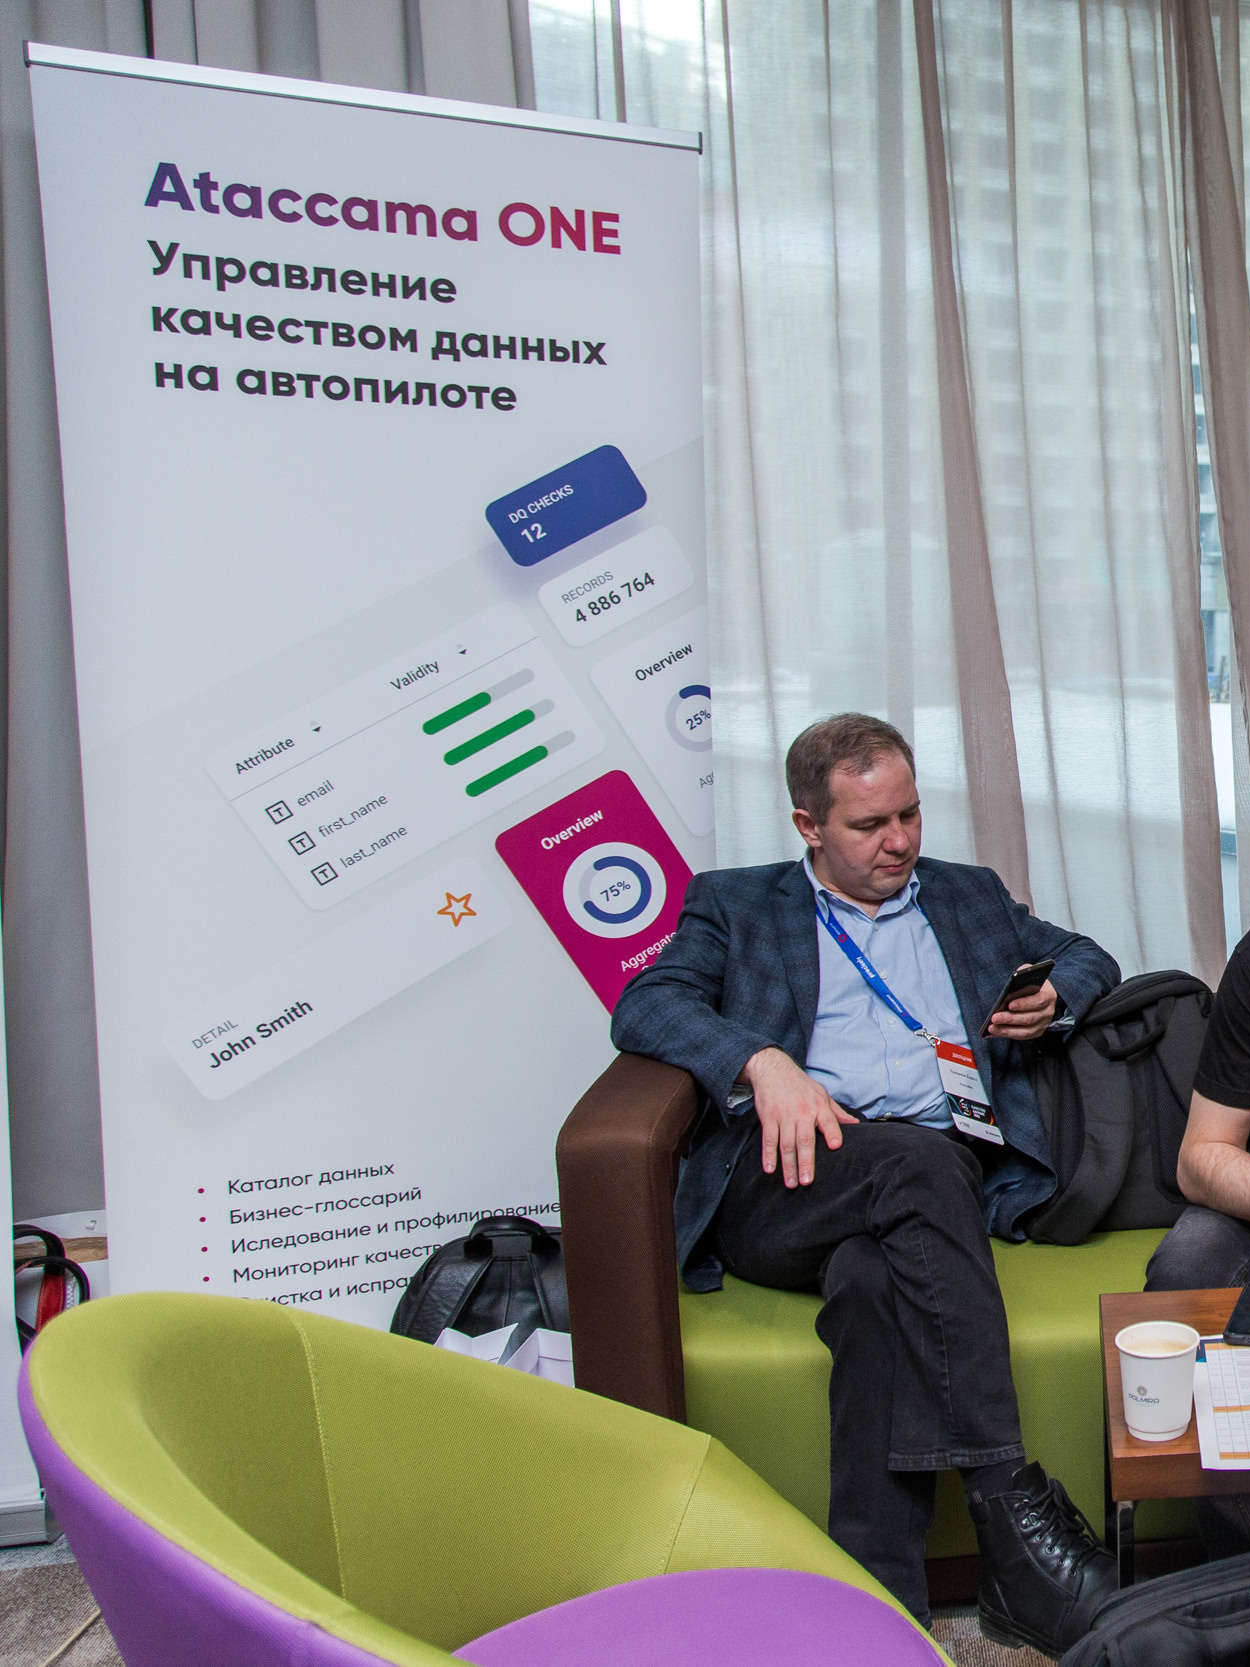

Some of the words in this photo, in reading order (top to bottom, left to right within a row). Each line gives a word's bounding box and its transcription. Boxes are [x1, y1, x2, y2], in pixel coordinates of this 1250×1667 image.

[144, 161, 479, 242] Ataccama
[498, 202, 622, 255] ONE
[147, 240, 457, 303] Управление
[151, 305, 419, 353] качеством
[431, 329, 608, 366] данных
[154, 361, 219, 393] на
[236, 366, 518, 411] автопилоте
[508, 508, 529, 524] DQ
[527, 484, 575, 514] CHECKS
[520, 522, 547, 543] 12
[561, 571, 614, 604] RECORDS
[575, 608, 587, 623] 4
[587, 590, 621, 616] 886
[620, 572, 655, 598] 764
[389, 661, 440, 690] Validity
[635, 644, 693, 681] Overview
[685, 709, 711, 731] 25%
[235, 738, 295, 775] Attribute
[297, 779, 335, 807] email
[318, 794, 388, 838] first_name
[541, 810, 604, 850] Overview
[339, 826, 408, 868] last_name
[600, 881, 631, 902] 75%
[192, 1020, 239, 1049] DETAIL
[210, 1035, 257, 1068] John
[256, 1001, 314, 1038] Smith
[228, 1174, 313, 1194] Каталог
[318, 1163, 395, 1186] данных
[229, 1187, 422, 1225] Бизнес-глоссарий
[231, 1224, 371, 1254] Иследование
[377, 1222, 389, 1234] и
[233, 1254, 360, 1284] Мониторинг
[329, 1286, 340, 1298] и
[346, 1275, 414, 1294] испра
